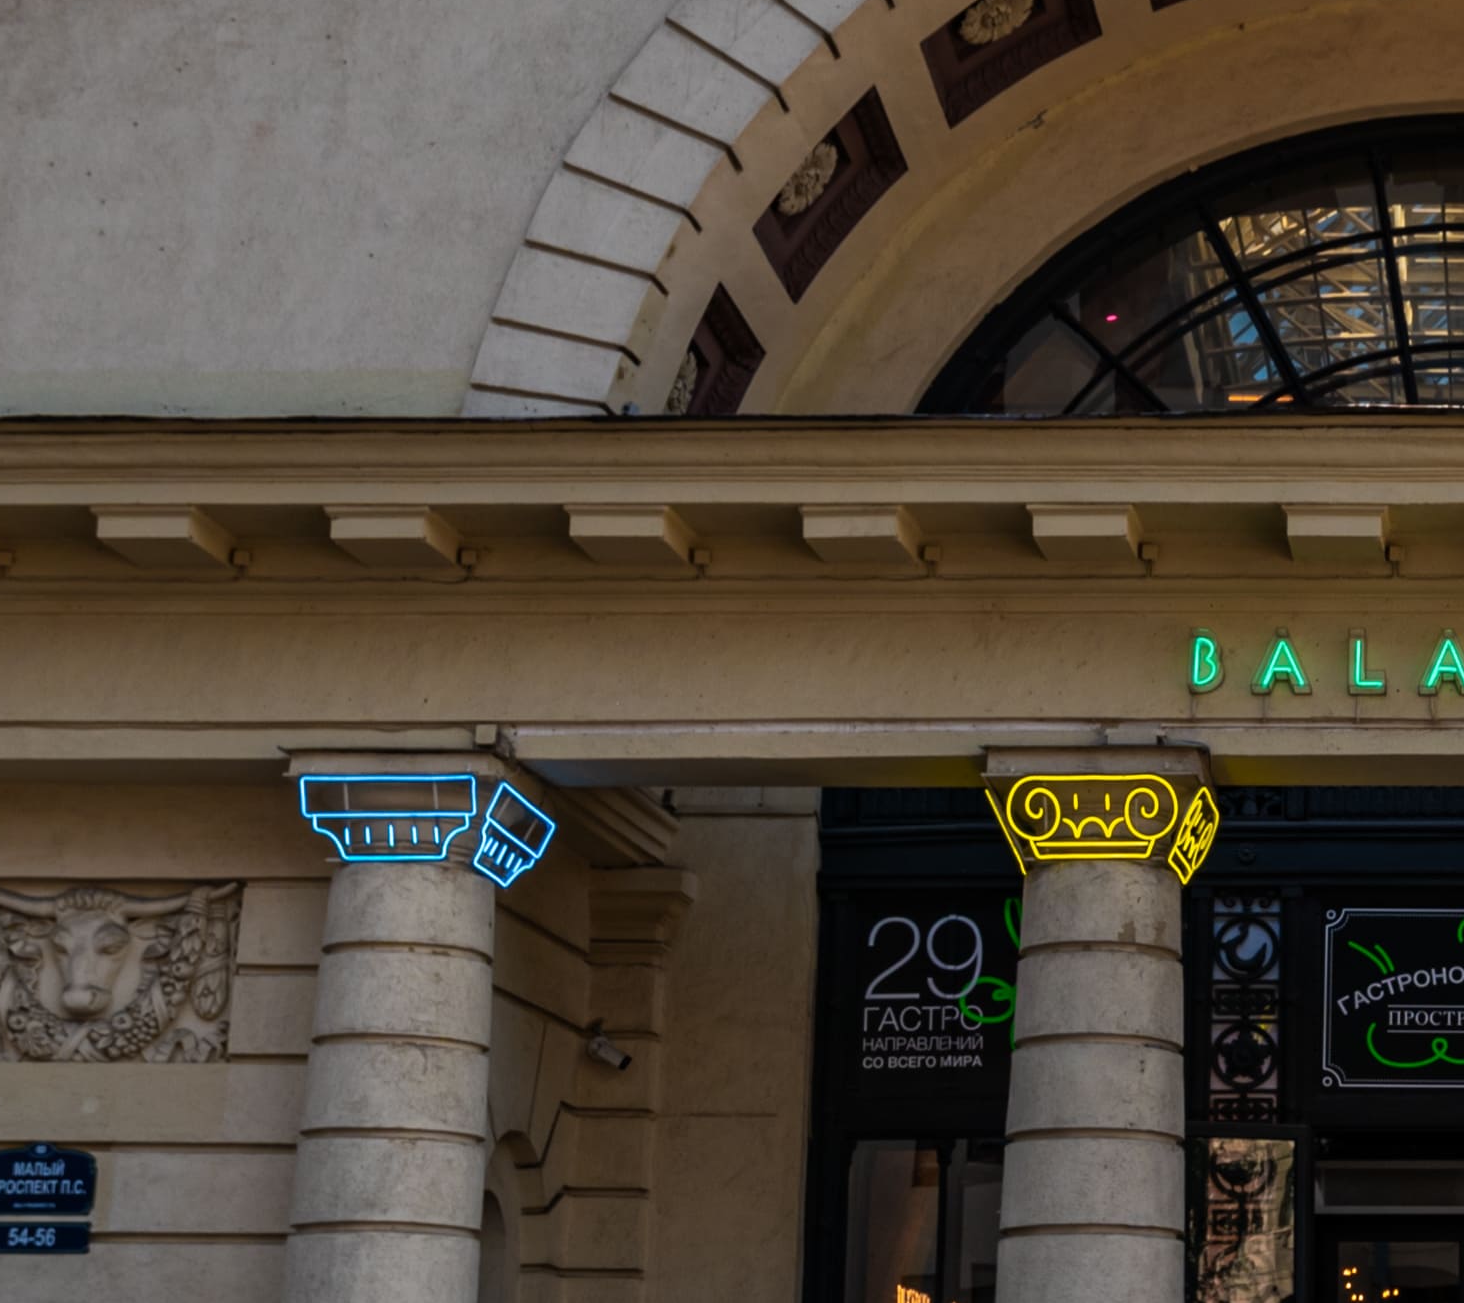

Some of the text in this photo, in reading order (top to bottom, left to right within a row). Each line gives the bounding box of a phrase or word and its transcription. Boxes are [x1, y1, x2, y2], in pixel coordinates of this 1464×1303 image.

[864, 913, 984, 1000] 29
[863, 1004, 984, 1032] ГАСТРО
[861, 1033, 984, 1052] НАПРАВЛЕНИЙ
[861, 1054, 984, 1070] СО ВСЕГО МИРА
[12, 1158, 66, 1176] МАЛЫЙ
[59, 1178, 88, 1195] П.С.
[7, 1226, 56, 1247] 54-56
